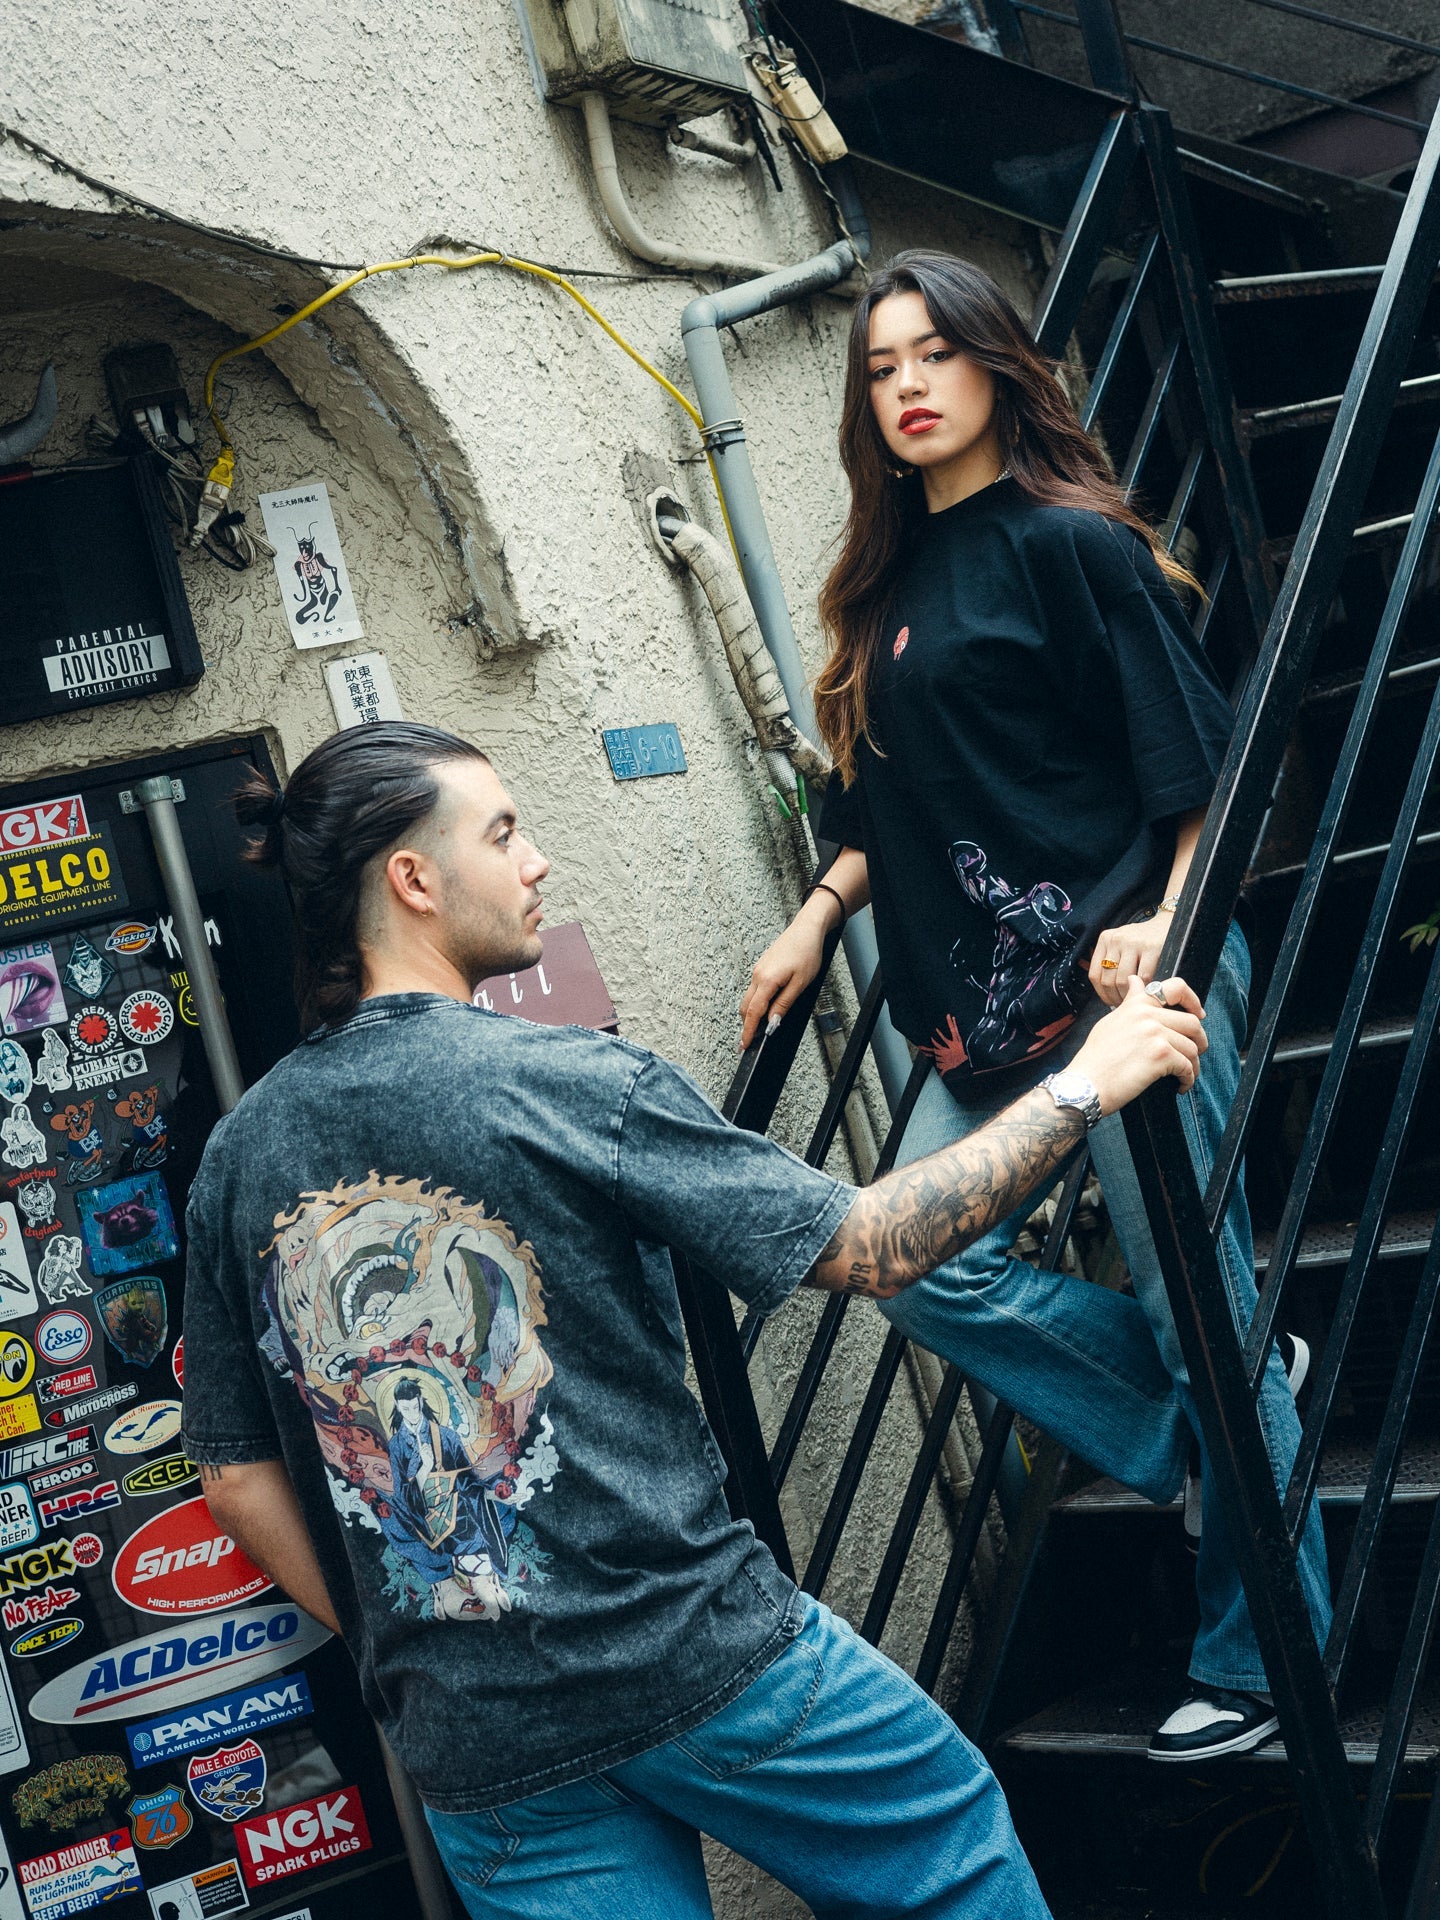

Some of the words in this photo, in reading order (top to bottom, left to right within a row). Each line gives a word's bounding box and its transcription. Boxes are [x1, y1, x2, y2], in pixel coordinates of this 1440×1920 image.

[56, 622, 147, 653] PARENTAL
[60, 640, 155, 687] ADVISORY
[68, 681, 116, 699] EXPLICIT
[121, 672, 159, 690] LYRICS
[343, 668, 367, 710] 飲食業
[358, 664, 380, 706] 東京都
[0, 801, 68, 850] GK
[41, 885, 90, 904] EQUIPMENT
[92, 880, 112, 892] LINE
[4, 913, 40, 926] GENERAL
[45, 904, 77, 917] MOTORS
[81, 894, 118, 908] PRODUCT
[112, 930, 152, 946] Dickies
[82, 1006, 104, 1016] RED
[131, 992, 152, 1005] RED
[152, 994, 171, 1017] HOT
[69, 1013, 93, 1053] PEPPERS
[103, 1011, 118, 1031] HOT
[121, 1002, 149, 1042] PEPPERS
[150, 1015, 172, 1042] CHILI
[93, 1031, 117, 1053] CHILI
[71, 1054, 119, 1076] PUBLIC
[75, 1069, 120, 1091] ENEMY
[24, 1219, 63, 1240] England
[45, 1328, 83, 1351] Esso
[55, 1379, 71, 1391] RED
[73, 1373, 91, 1386] LINE
[6, 1422, 26, 1437] Can!
[10, 1414, 17, 1424] It
[66, 1437, 90, 1458] TIRE
[32, 1461, 94, 1493] FERODO
[41, 1483, 119, 1526] HRC
[1, 1528, 31, 1546] BEEP!
[75, 1541, 96, 1553] NGK
[0, 1544, 73, 1592] NGK
[147, 1597, 176, 1608] HIGH
[178, 1577, 264, 1608] PERFORMANCE
[4, 1600, 26, 1629] NO
[26, 1588, 80, 1622] FEAR
[16, 1633, 47, 1655] RACE
[48, 1621, 79, 1641] TECH
[80, 1611, 299, 1701] ACDelco
[152, 1704, 233, 1747] PAN
[238, 1683, 304, 1721] AM
[142, 1750, 164, 1762] PAN
[167, 1732, 221, 1755] AMERICAN
[223, 1720, 257, 1736] WORLD
[259, 1705, 304, 1725] AIRWAYS
[192, 1762, 213, 1776] WILE
[214, 1758, 223, 1769] E.
[224, 1746, 257, 1766] COYOTE
[213, 1765, 241, 1778] GENIUS
[139, 1793, 172, 1811] UNION
[145, 1805, 177, 1841] 76
[244, 1794, 355, 1864] NGK
[153, 1831, 179, 1843] GASOLINE
[20, 1855, 57, 1883] ROAD
[58, 1837, 111, 1870] RUNNER
[255, 1854, 308, 1882] SPARK
[310, 1836, 361, 1863] PLUGS
[29, 1881, 53, 1897] RUNS
[54, 1877, 66, 1888] AS
[67, 1870, 87, 1885] FAST
[32, 1896, 43, 1906] AS
[45, 1879, 91, 1901] LIGHTNING
[67, 1891, 100, 1913] BEEP!
